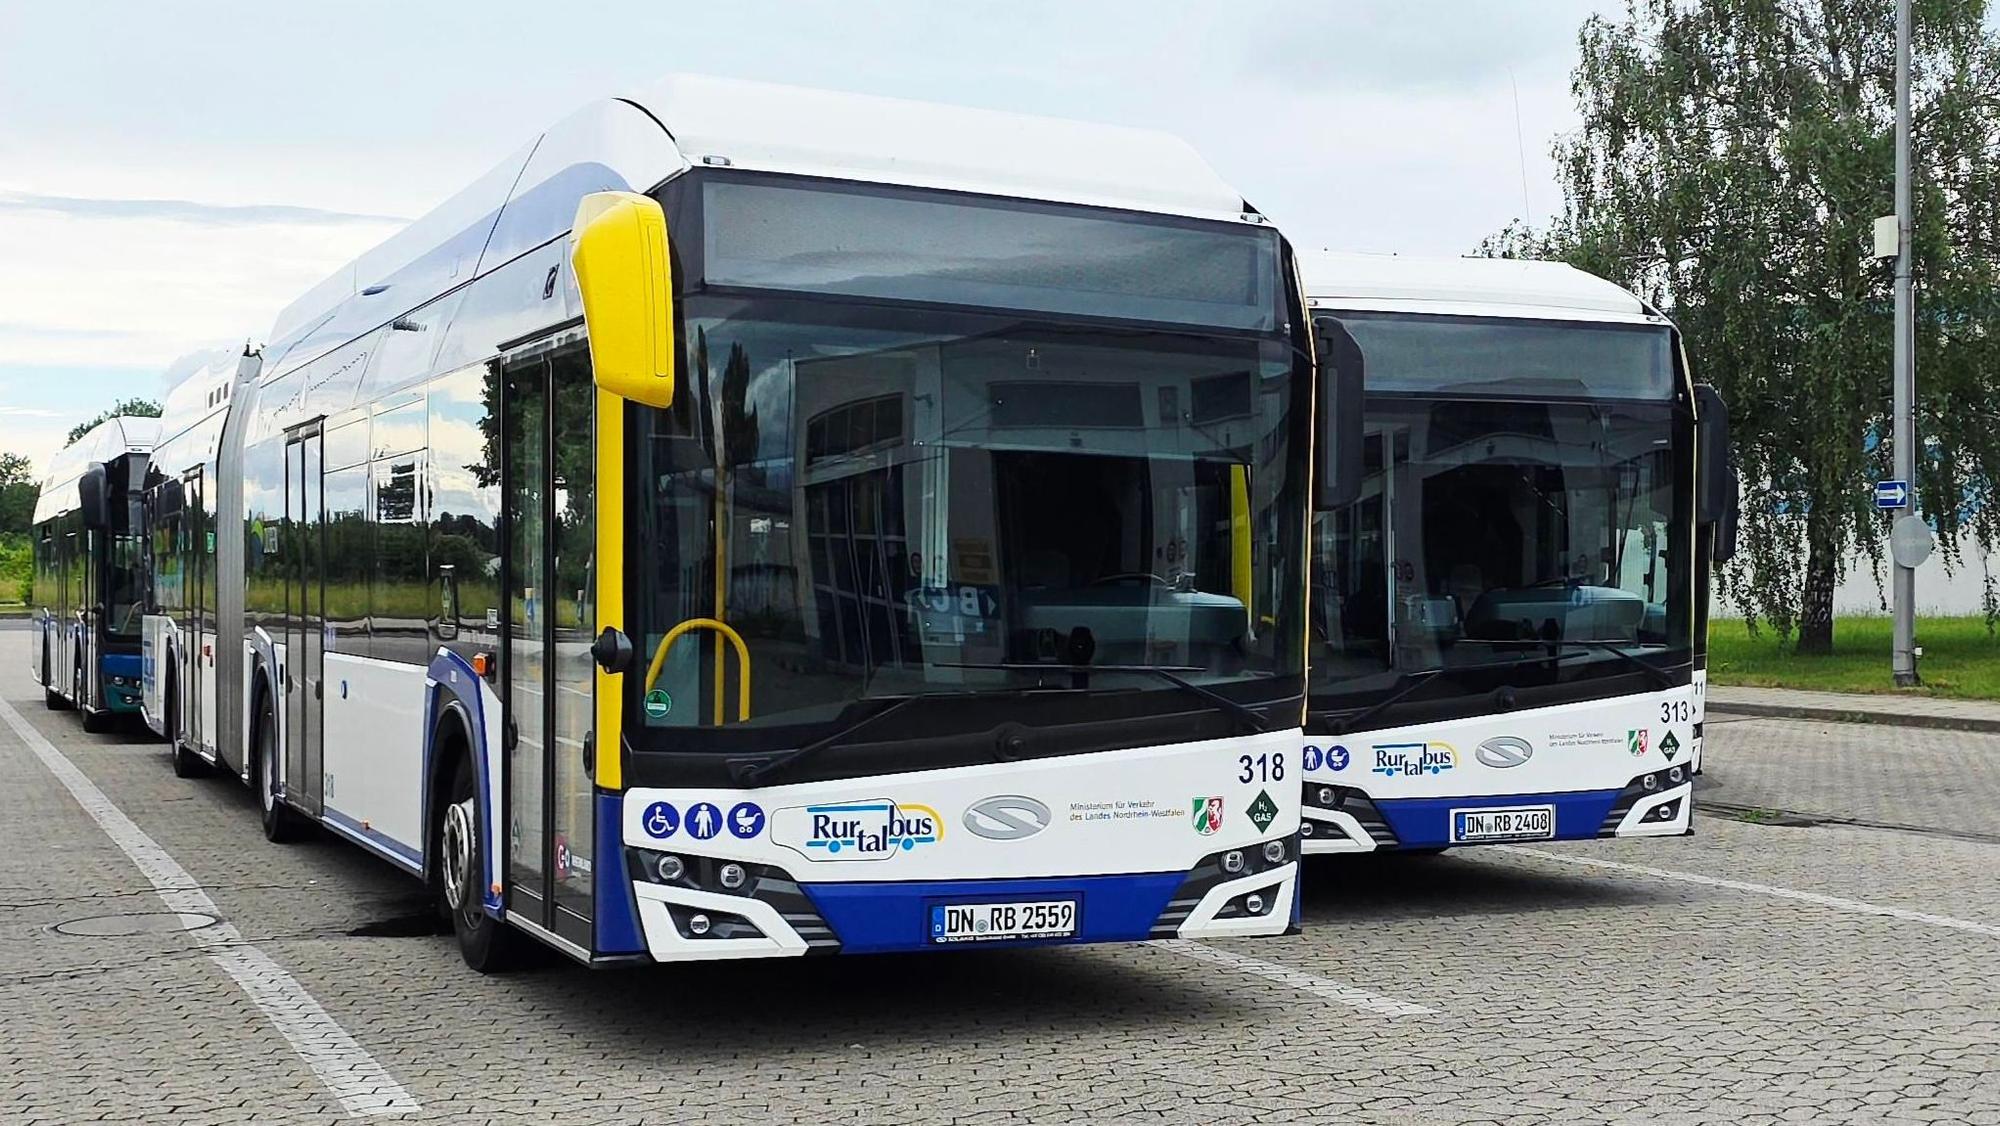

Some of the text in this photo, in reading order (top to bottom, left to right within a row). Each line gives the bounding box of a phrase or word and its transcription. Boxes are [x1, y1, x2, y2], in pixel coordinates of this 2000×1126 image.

[1661, 701, 1688, 723] 313
[1238, 753, 1285, 784] 318
[1070, 799, 1155, 811] Ministerium für Verkehr
[1070, 812, 1083, 821] des
[1085, 811, 1111, 821] Landes
[1253, 812, 1272, 823] GAS
[1467, 813, 1547, 833] DN RB 2408
[947, 905, 1072, 933] DN RB 2559
